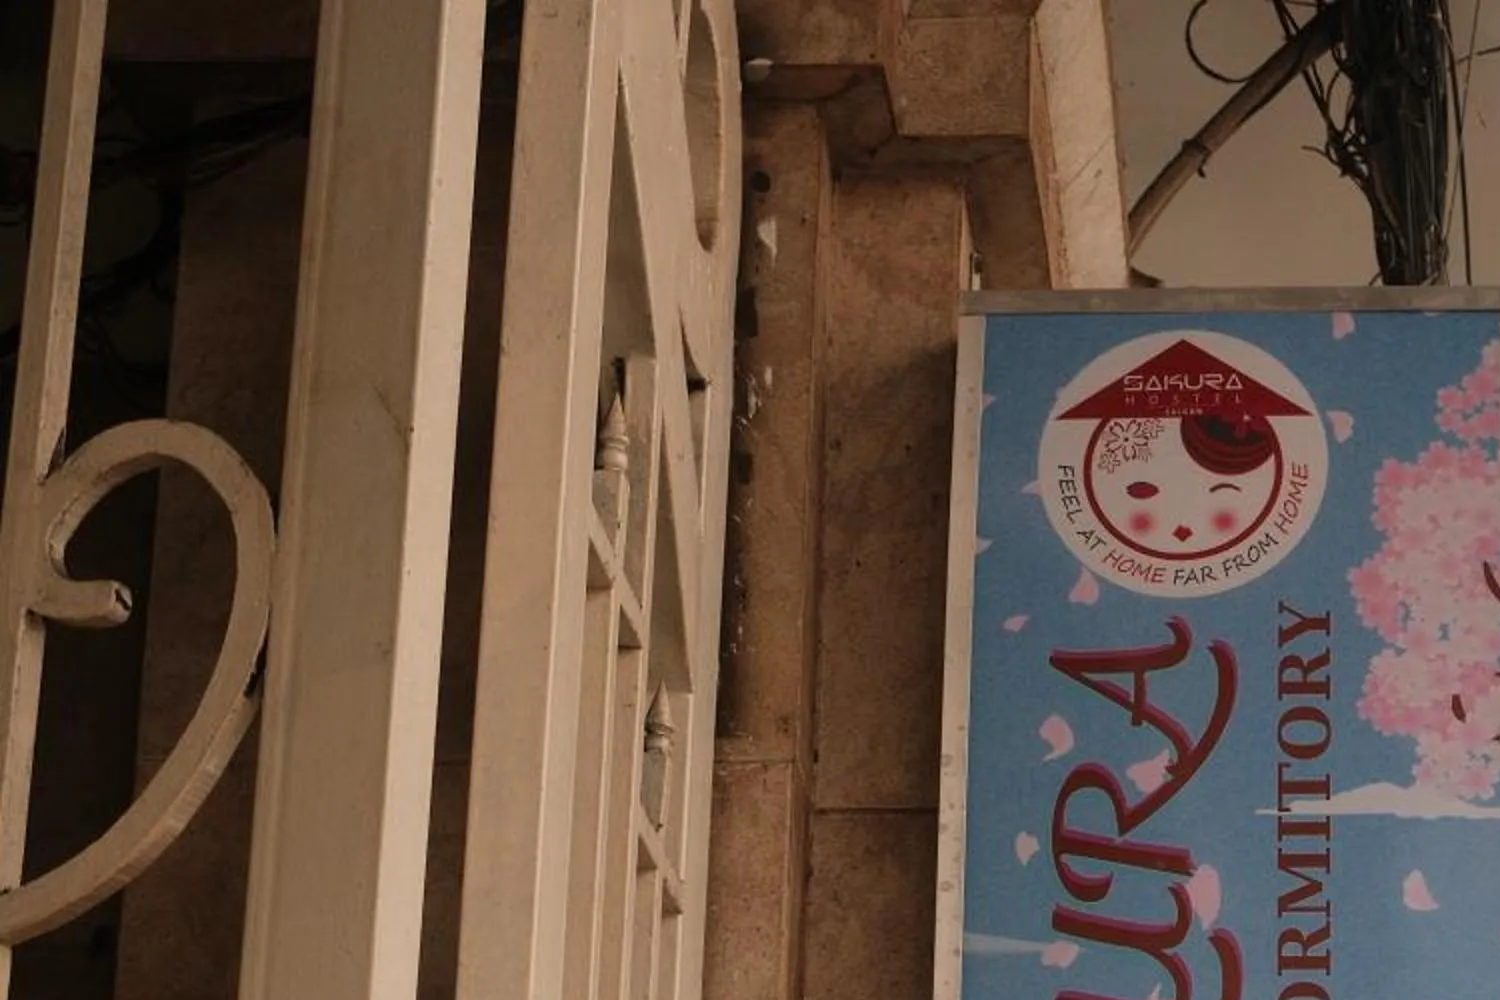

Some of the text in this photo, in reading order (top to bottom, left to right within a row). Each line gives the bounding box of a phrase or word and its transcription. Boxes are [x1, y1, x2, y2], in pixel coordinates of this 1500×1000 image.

[1123, 373, 1243, 392] SAKURA
[1124, 392, 1243, 407] HOSTEL
[1057, 462, 1309, 586] FEEL AT HOME FAR FROM HOME
